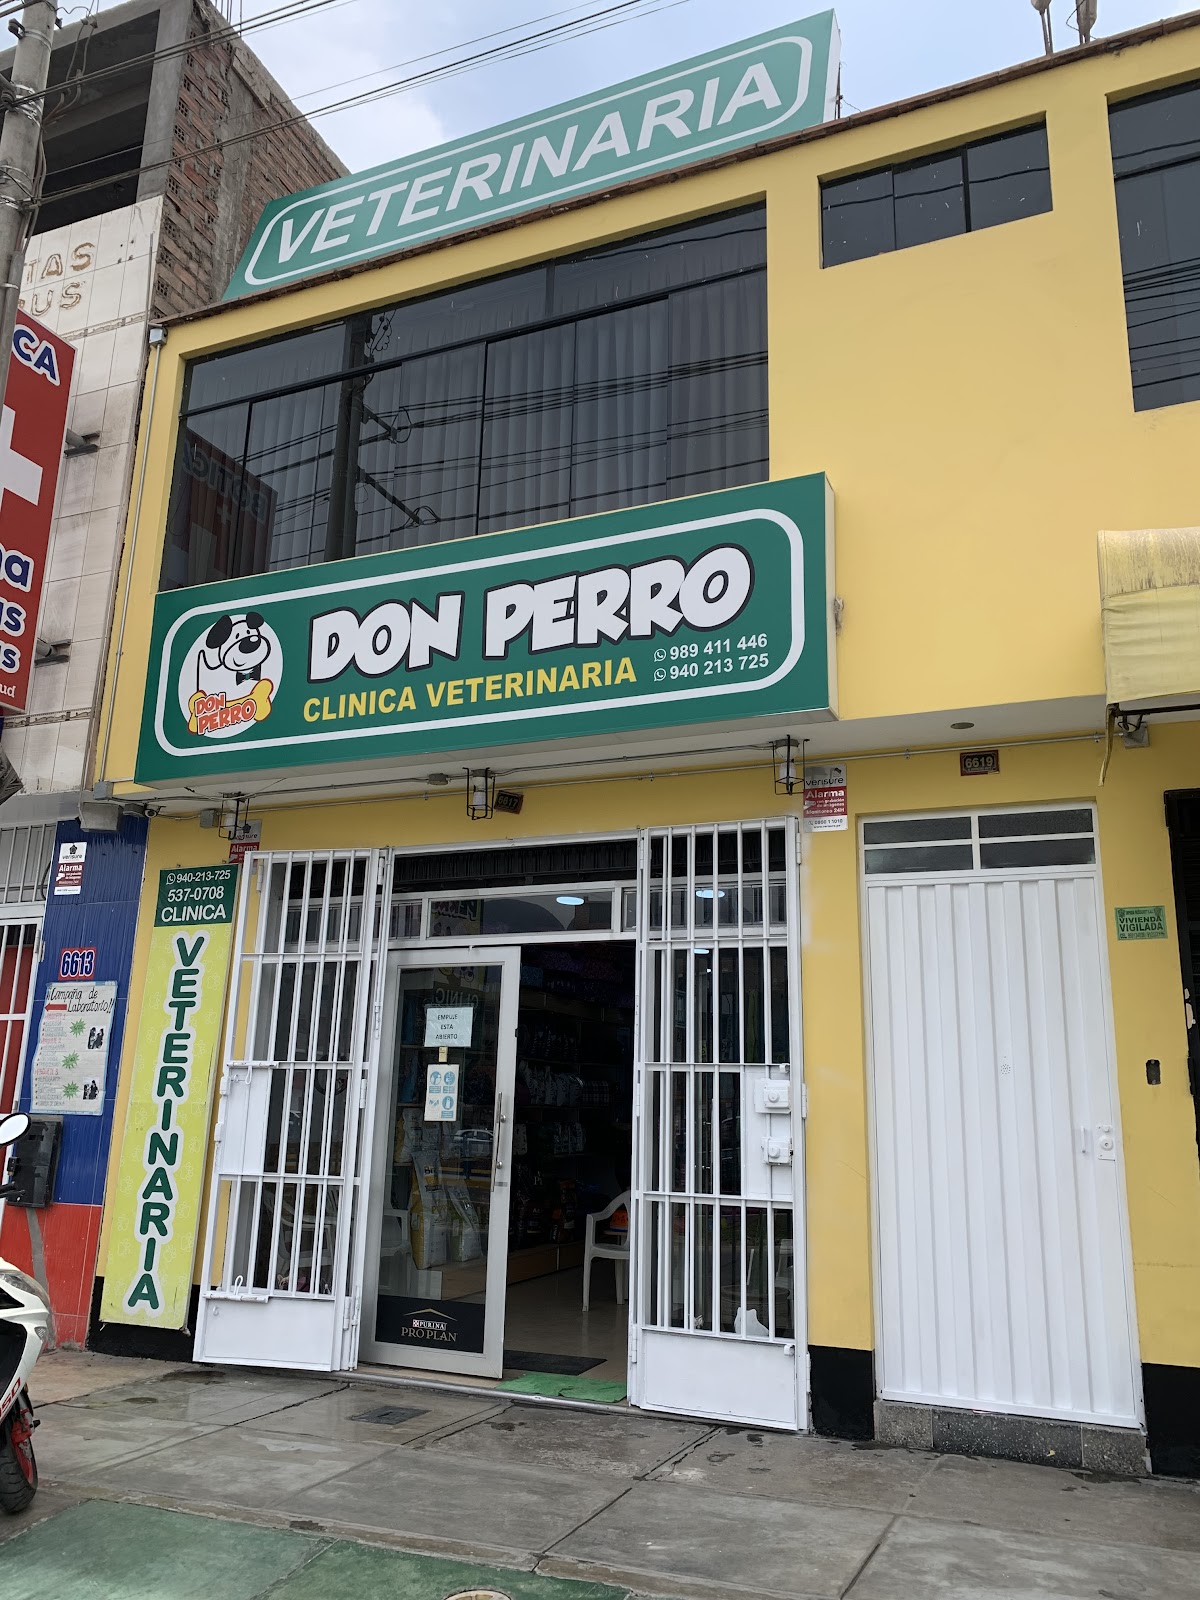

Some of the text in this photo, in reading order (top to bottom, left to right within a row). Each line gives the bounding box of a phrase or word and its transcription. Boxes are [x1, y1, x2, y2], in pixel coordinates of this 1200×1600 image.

[279, 62, 782, 263] VETERINARIA
[24, 242, 95, 284] TAS
[0, 545, 33, 591] a
[0, 602, 25, 635] s
[307, 542, 755, 683] DON PERRO
[0, 645, 18, 672] s
[670, 633, 768, 660] 989 411 446
[669, 653, 769, 679] 940 213 725
[303, 657, 637, 722] CLINICA VETERINARIA
[194, 692, 226, 717] DON
[197, 698, 257, 735] PERRO
[965, 756, 994, 768] 6619
[806, 777, 844, 786] verisure
[806, 789, 845, 799] Alarma
[58, 864, 83, 872] Alarma
[176, 869, 231, 884] 940-213-725
[167, 886, 224, 902] 537-0708
[161, 904, 226, 922] CLINICA
[1119, 915, 1162, 924] VIVIENDA
[1119, 922, 1164, 932] VIGILADA
[61, 950, 95, 977] 6613
[88, 985, 98, 999] de
[128, 936, 205, 1310] VETERINARIA
[401, 1326, 457, 1342] PRO PLAN
[419, 1321, 446, 1330] PURINA
